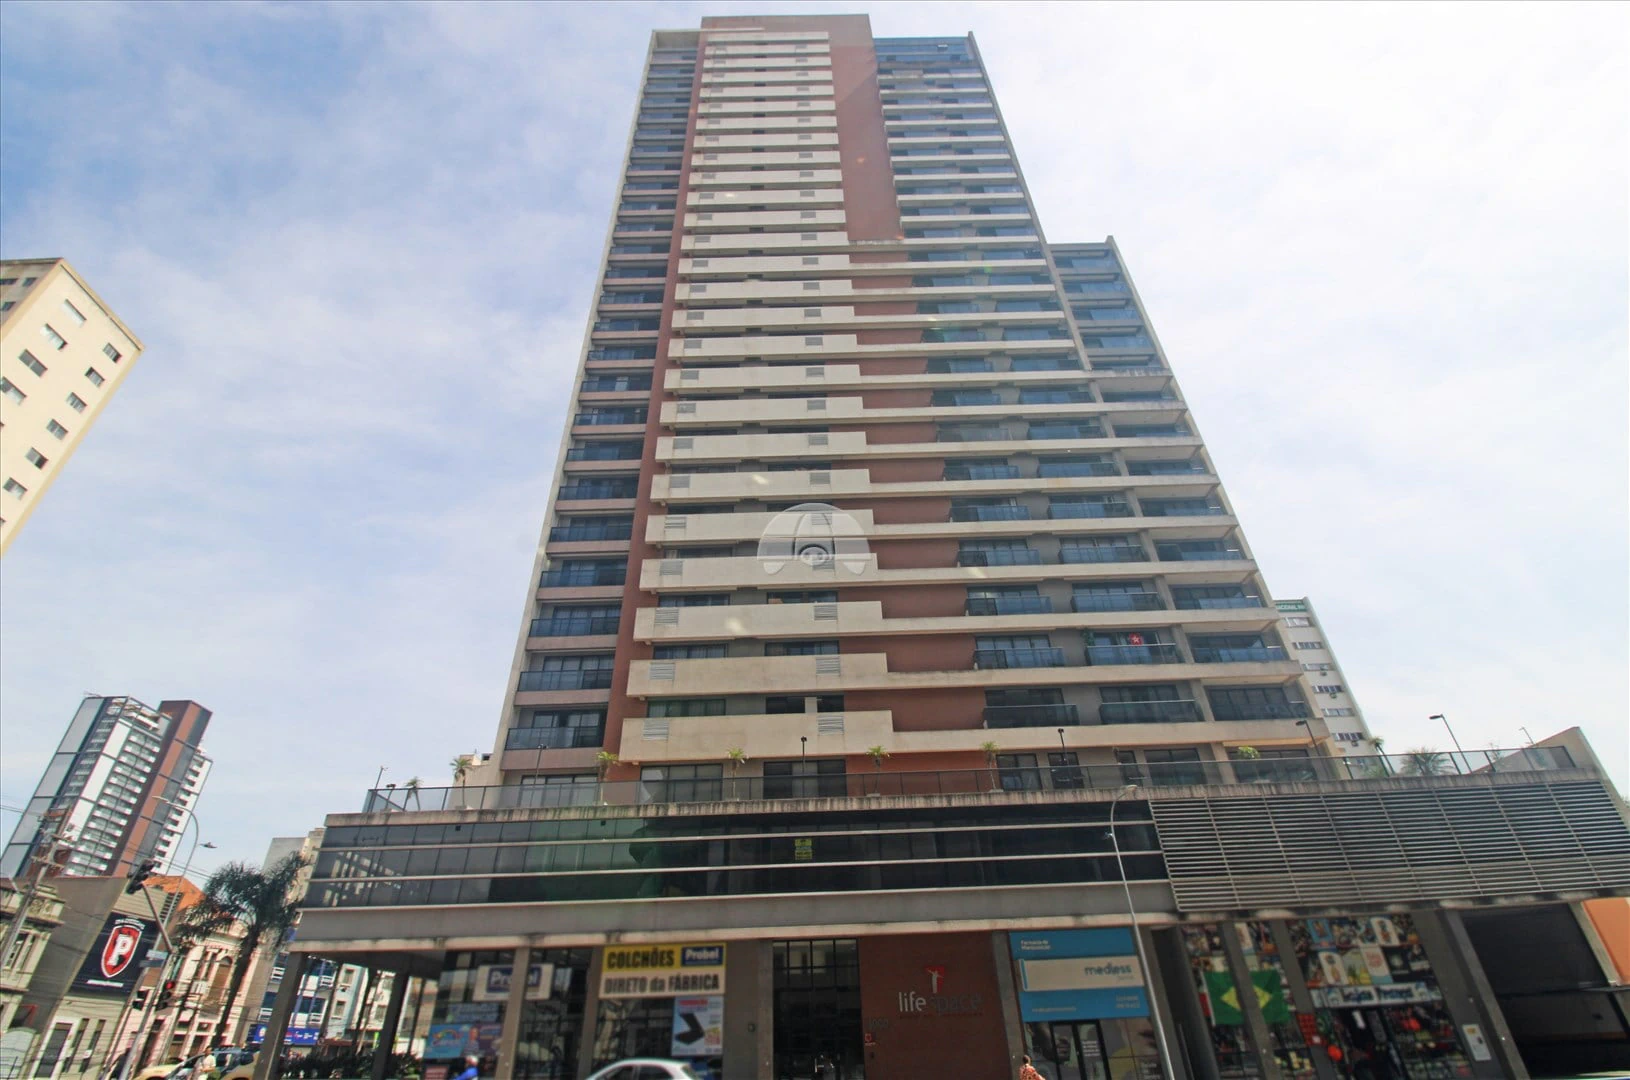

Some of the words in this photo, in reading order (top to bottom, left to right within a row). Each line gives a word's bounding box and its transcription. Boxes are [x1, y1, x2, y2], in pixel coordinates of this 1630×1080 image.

[607, 947, 674, 969] COLCHÕES
[685, 948, 719, 961] Probel
[604, 976, 648, 994] DIRETO
[649, 976, 666, 992] da
[668, 972, 719, 991] FÁBRICA
